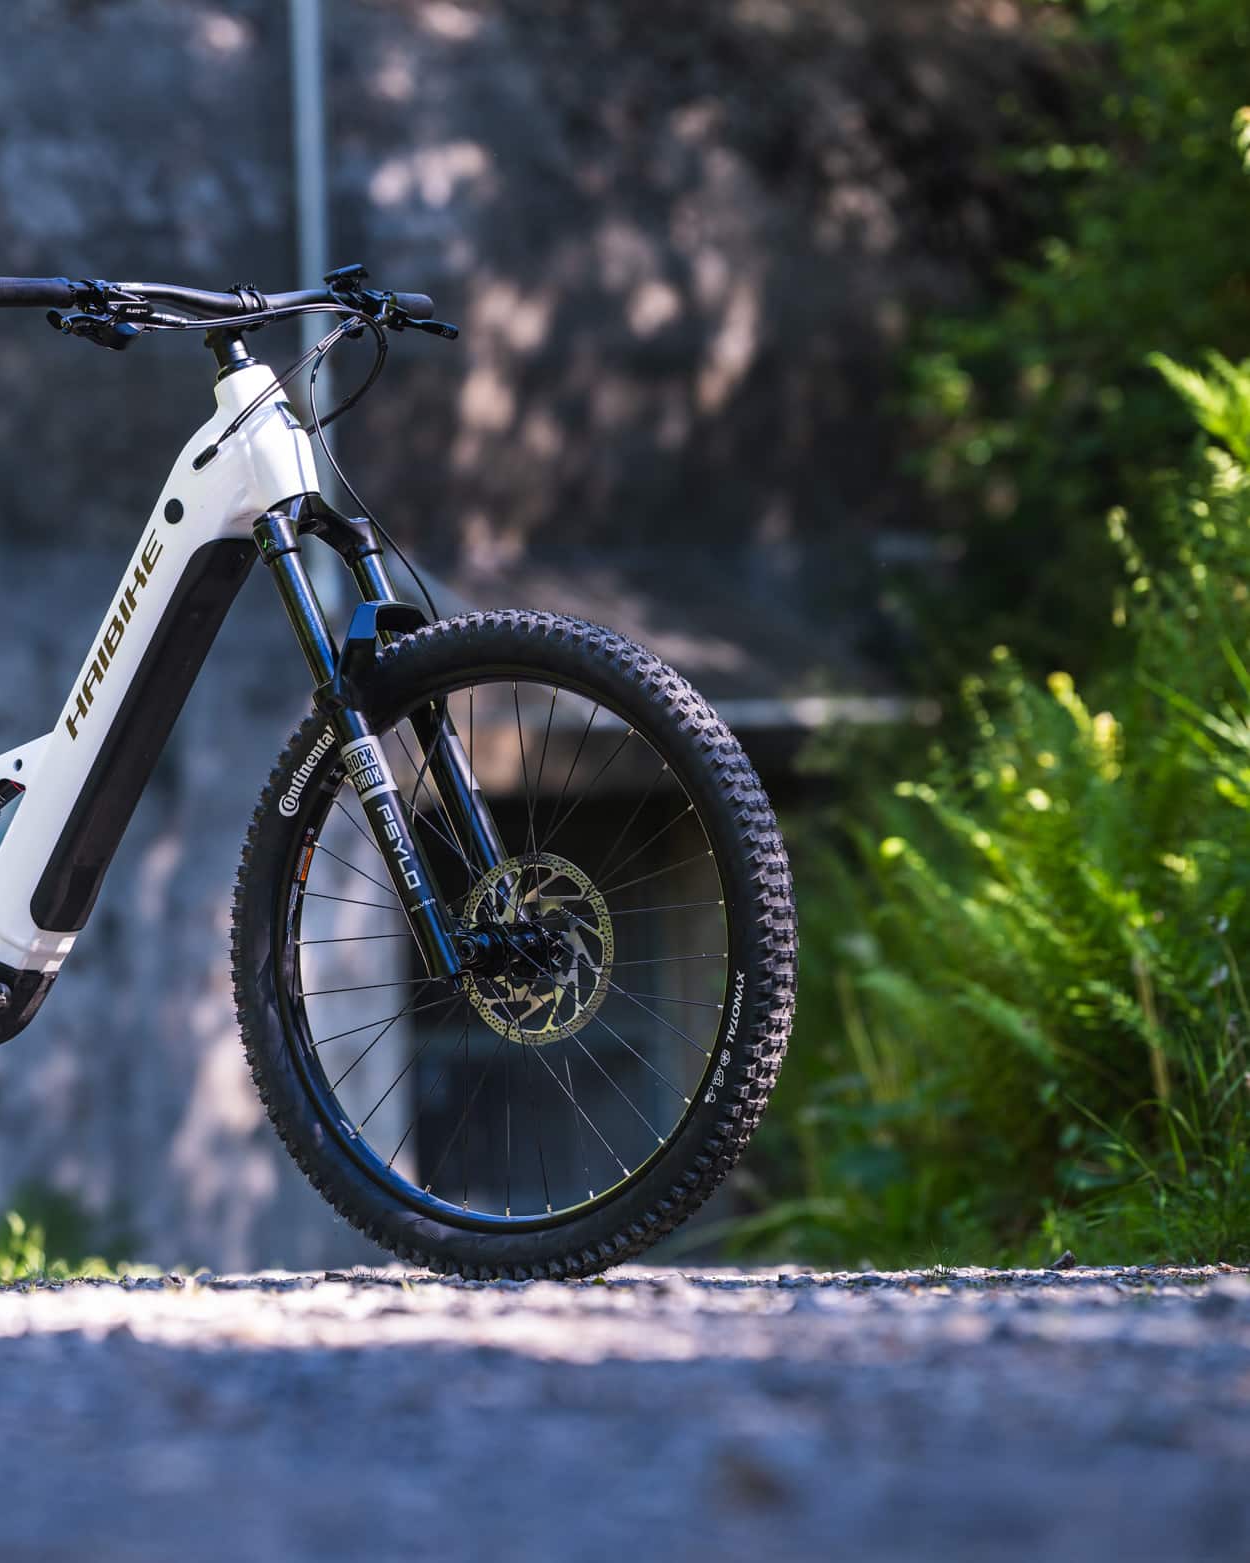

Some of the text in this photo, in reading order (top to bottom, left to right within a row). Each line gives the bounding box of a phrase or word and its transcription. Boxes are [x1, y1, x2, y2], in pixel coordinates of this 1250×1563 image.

[65, 528, 164, 741] HAIBIKE
[353, 766, 383, 792] SHOX
[375, 803, 423, 891] PSYLO
[725, 969, 746, 1044] XYNOTAL
